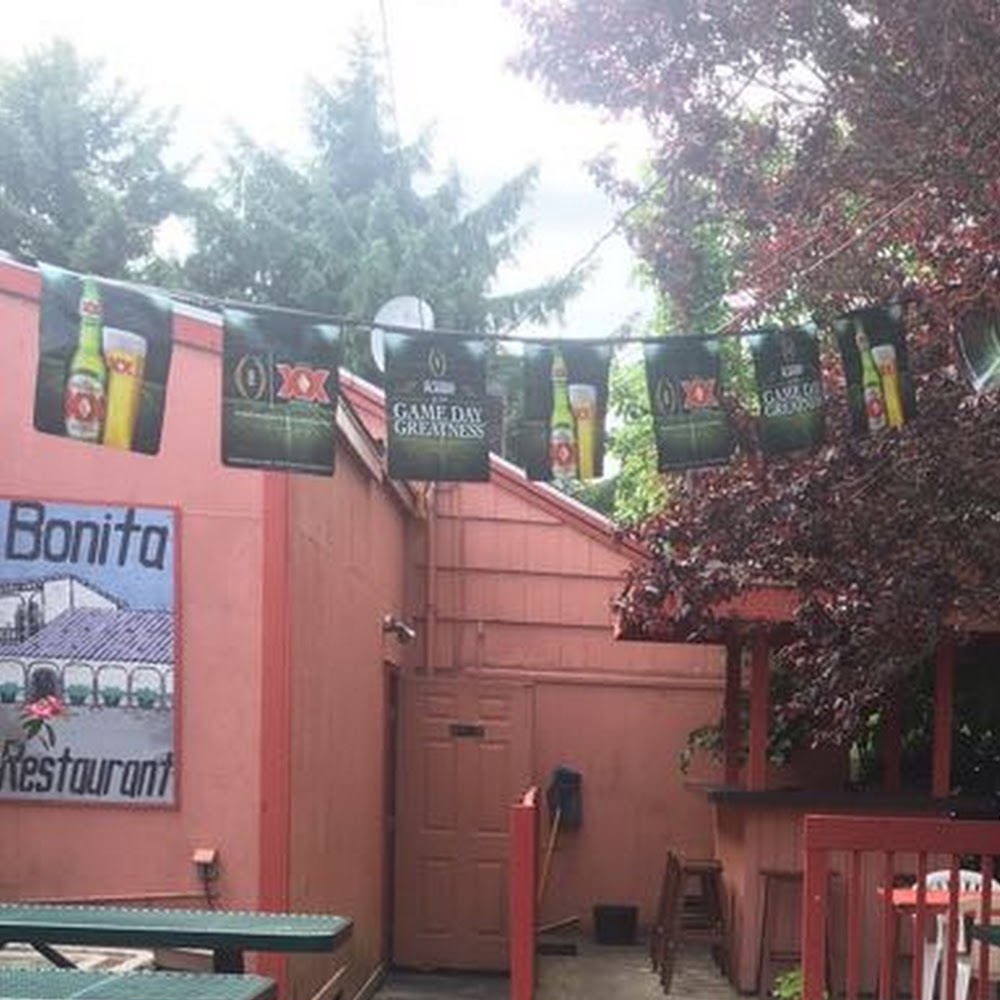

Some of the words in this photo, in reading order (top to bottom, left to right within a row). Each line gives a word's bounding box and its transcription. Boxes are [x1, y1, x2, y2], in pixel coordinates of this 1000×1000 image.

[276, 362, 331, 404] XX
[393, 402, 448, 420] GAME
[451, 405, 482, 422] DAY
[394, 420, 487, 439] GREATNESS
[5, 500, 170, 571] Bonita
[0, 740, 176, 798] Restaurant
